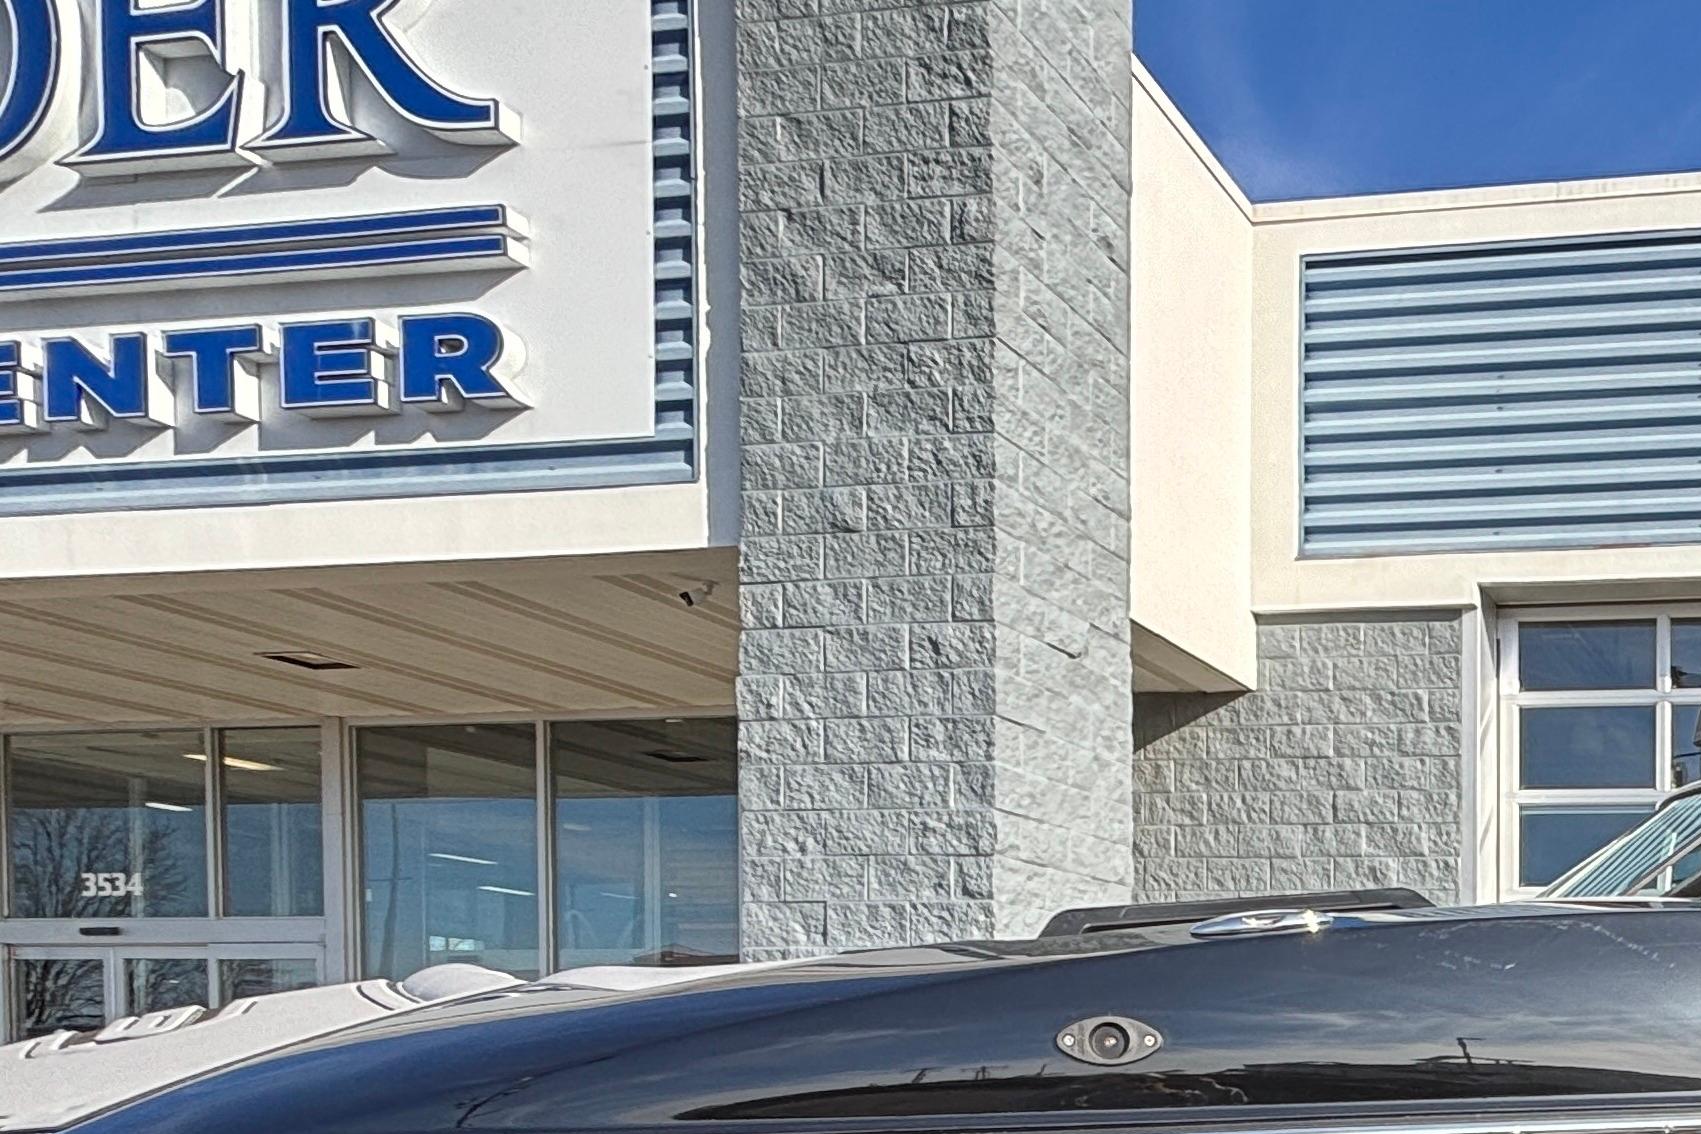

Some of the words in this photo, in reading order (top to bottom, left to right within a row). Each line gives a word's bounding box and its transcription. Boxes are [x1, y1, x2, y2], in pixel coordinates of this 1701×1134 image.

[0, 0, 506, 166] ER
[0, 311, 510, 426] NTER
[80, 872, 144, 897] 3534
